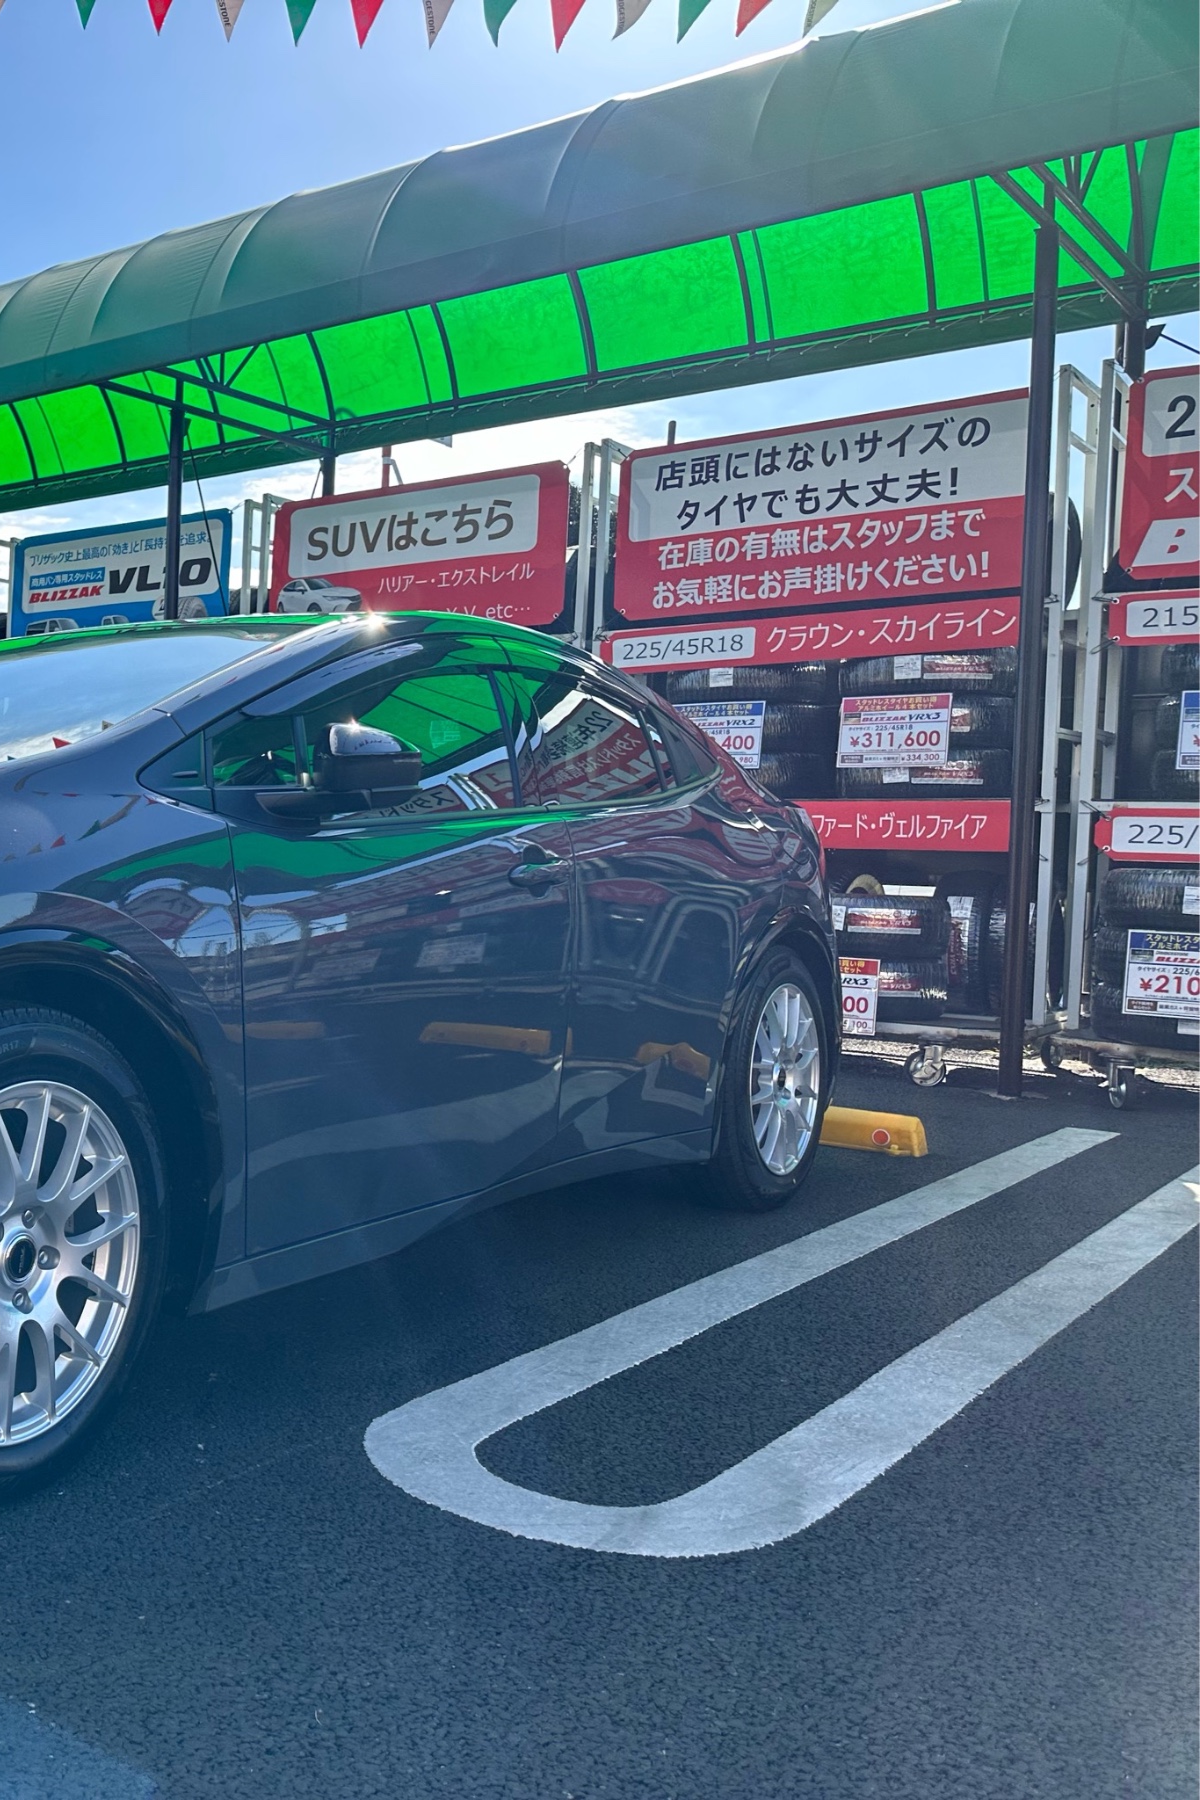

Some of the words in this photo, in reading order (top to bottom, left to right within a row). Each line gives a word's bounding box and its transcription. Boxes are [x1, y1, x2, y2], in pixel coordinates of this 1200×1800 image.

[1164, 395, 1197, 439] 2
[655, 416, 991, 492] 店頭にはないサイズの
[1163, 467, 1199, 503] ス
[306, 499, 514, 561] SUVはこちら
[657, 507, 986, 570] 在庫の有無はスタッフまで
[108, 556, 212, 595] VL0
[377, 562, 535, 595] ハリアー・エクストレイル
[29, 584, 105, 604] BLIZZAK
[765, 608, 1018, 653] クラウン・スカイライン
[1141, 606, 1199, 628] 215
[622, 637, 744, 661] 225/45R18
[908, 712, 942, 721] VRX3
[850, 730, 941, 749] ¥311,600
[811, 811, 988, 840] ファード・ヴェルファイア
[1127, 823, 1199, 849] 225/
[839, 960, 865, 968] 買い得
